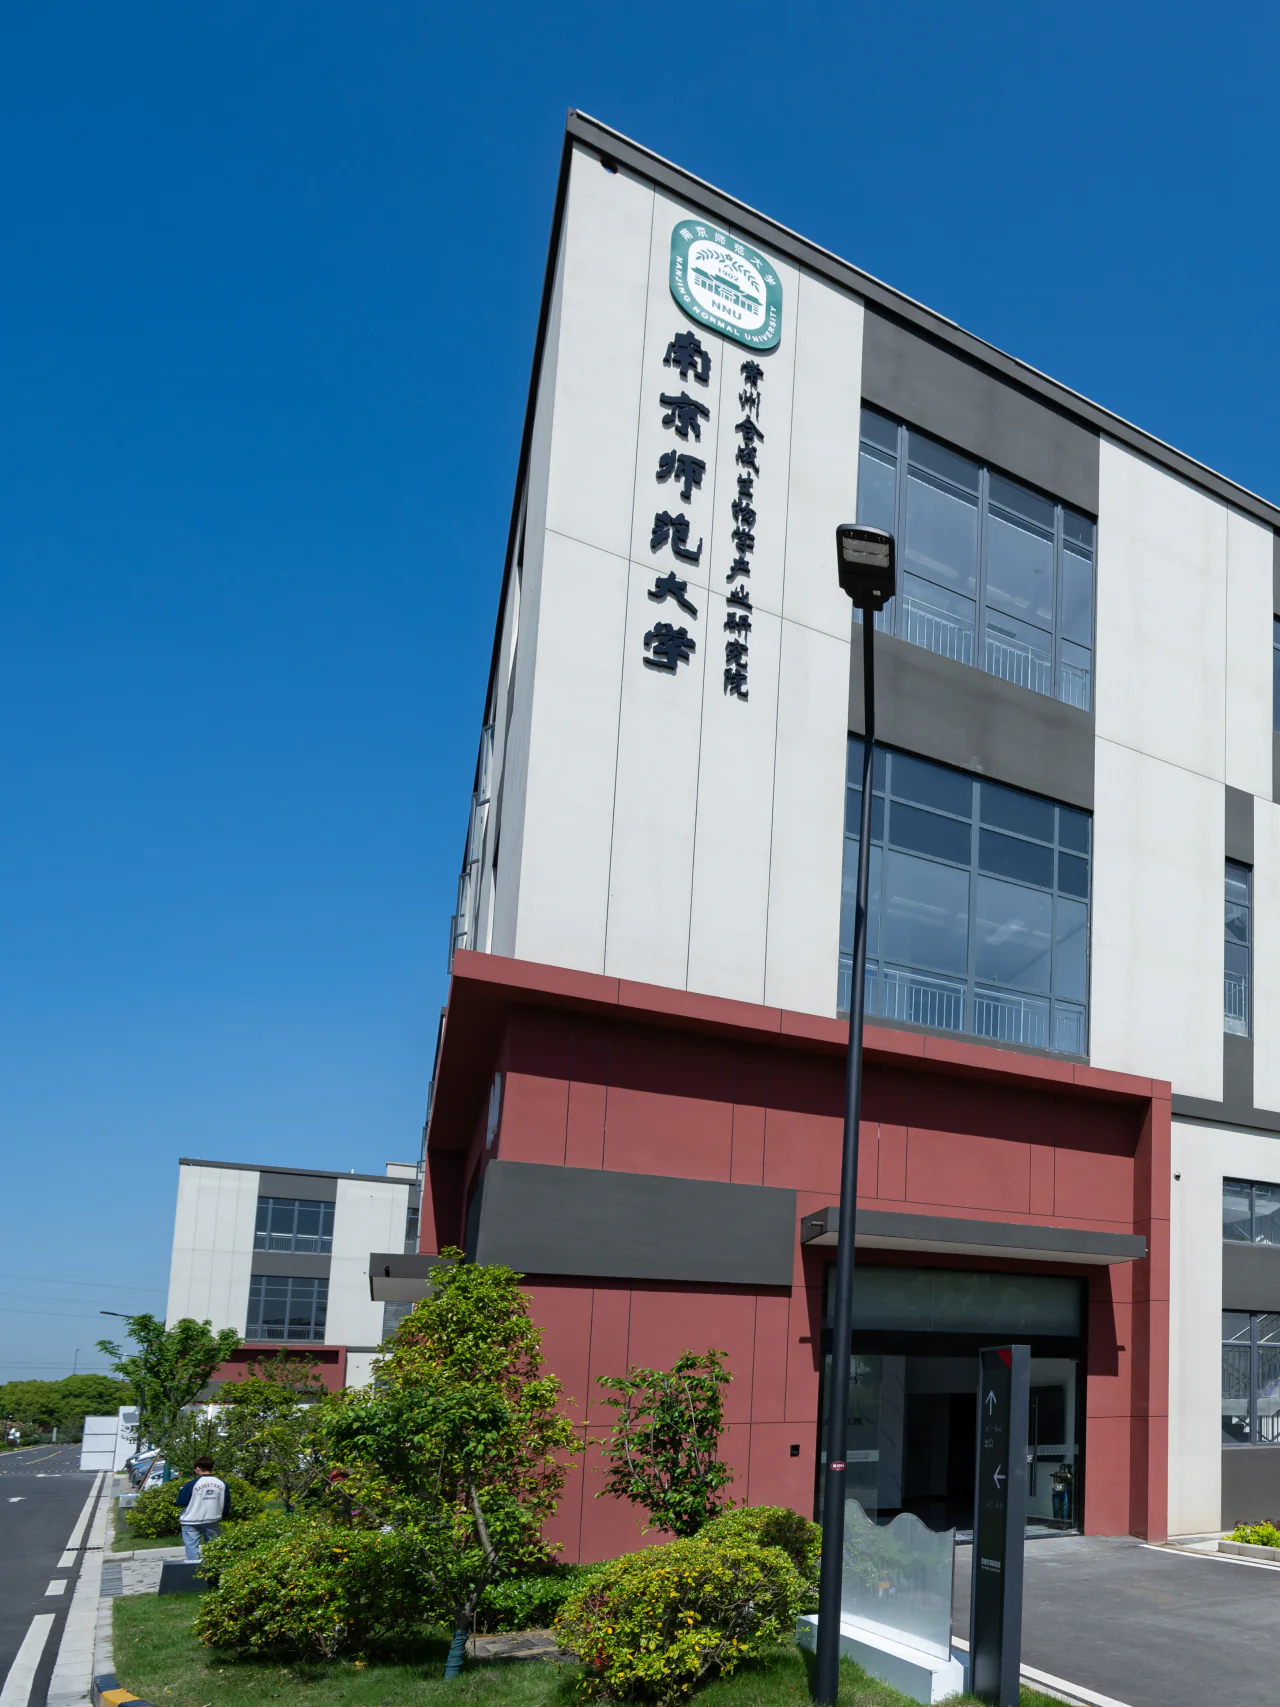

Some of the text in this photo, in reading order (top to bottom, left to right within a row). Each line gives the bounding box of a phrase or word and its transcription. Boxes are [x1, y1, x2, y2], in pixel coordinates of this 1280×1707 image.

[679, 225, 777, 287] 南京师范大学
[717, 268, 740, 282] 1902
[675, 255, 777, 343] NANJING NORMAL UNIVERSITY
[711, 299, 742, 320] NNU
[643, 331, 711, 673] 南京师范大学
